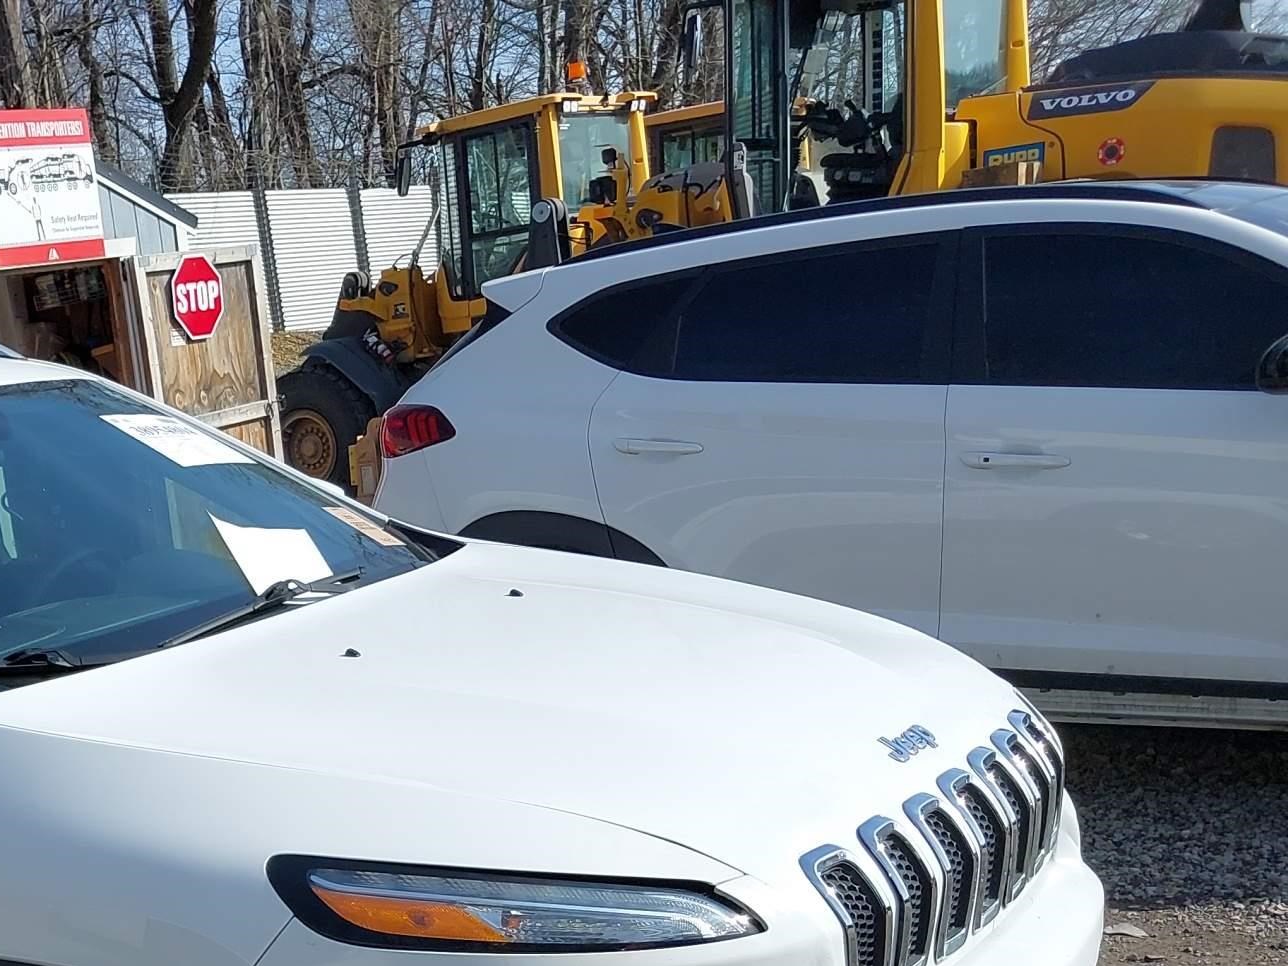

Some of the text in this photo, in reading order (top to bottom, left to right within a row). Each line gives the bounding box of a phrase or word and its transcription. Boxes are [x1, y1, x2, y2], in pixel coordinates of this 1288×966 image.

[1039, 89, 1137, 111] VOLVO
[25, 120, 85, 138] TRANSPORTERS!
[175, 280, 220, 314] STOP
[876, 724, 939, 763] Jeep
